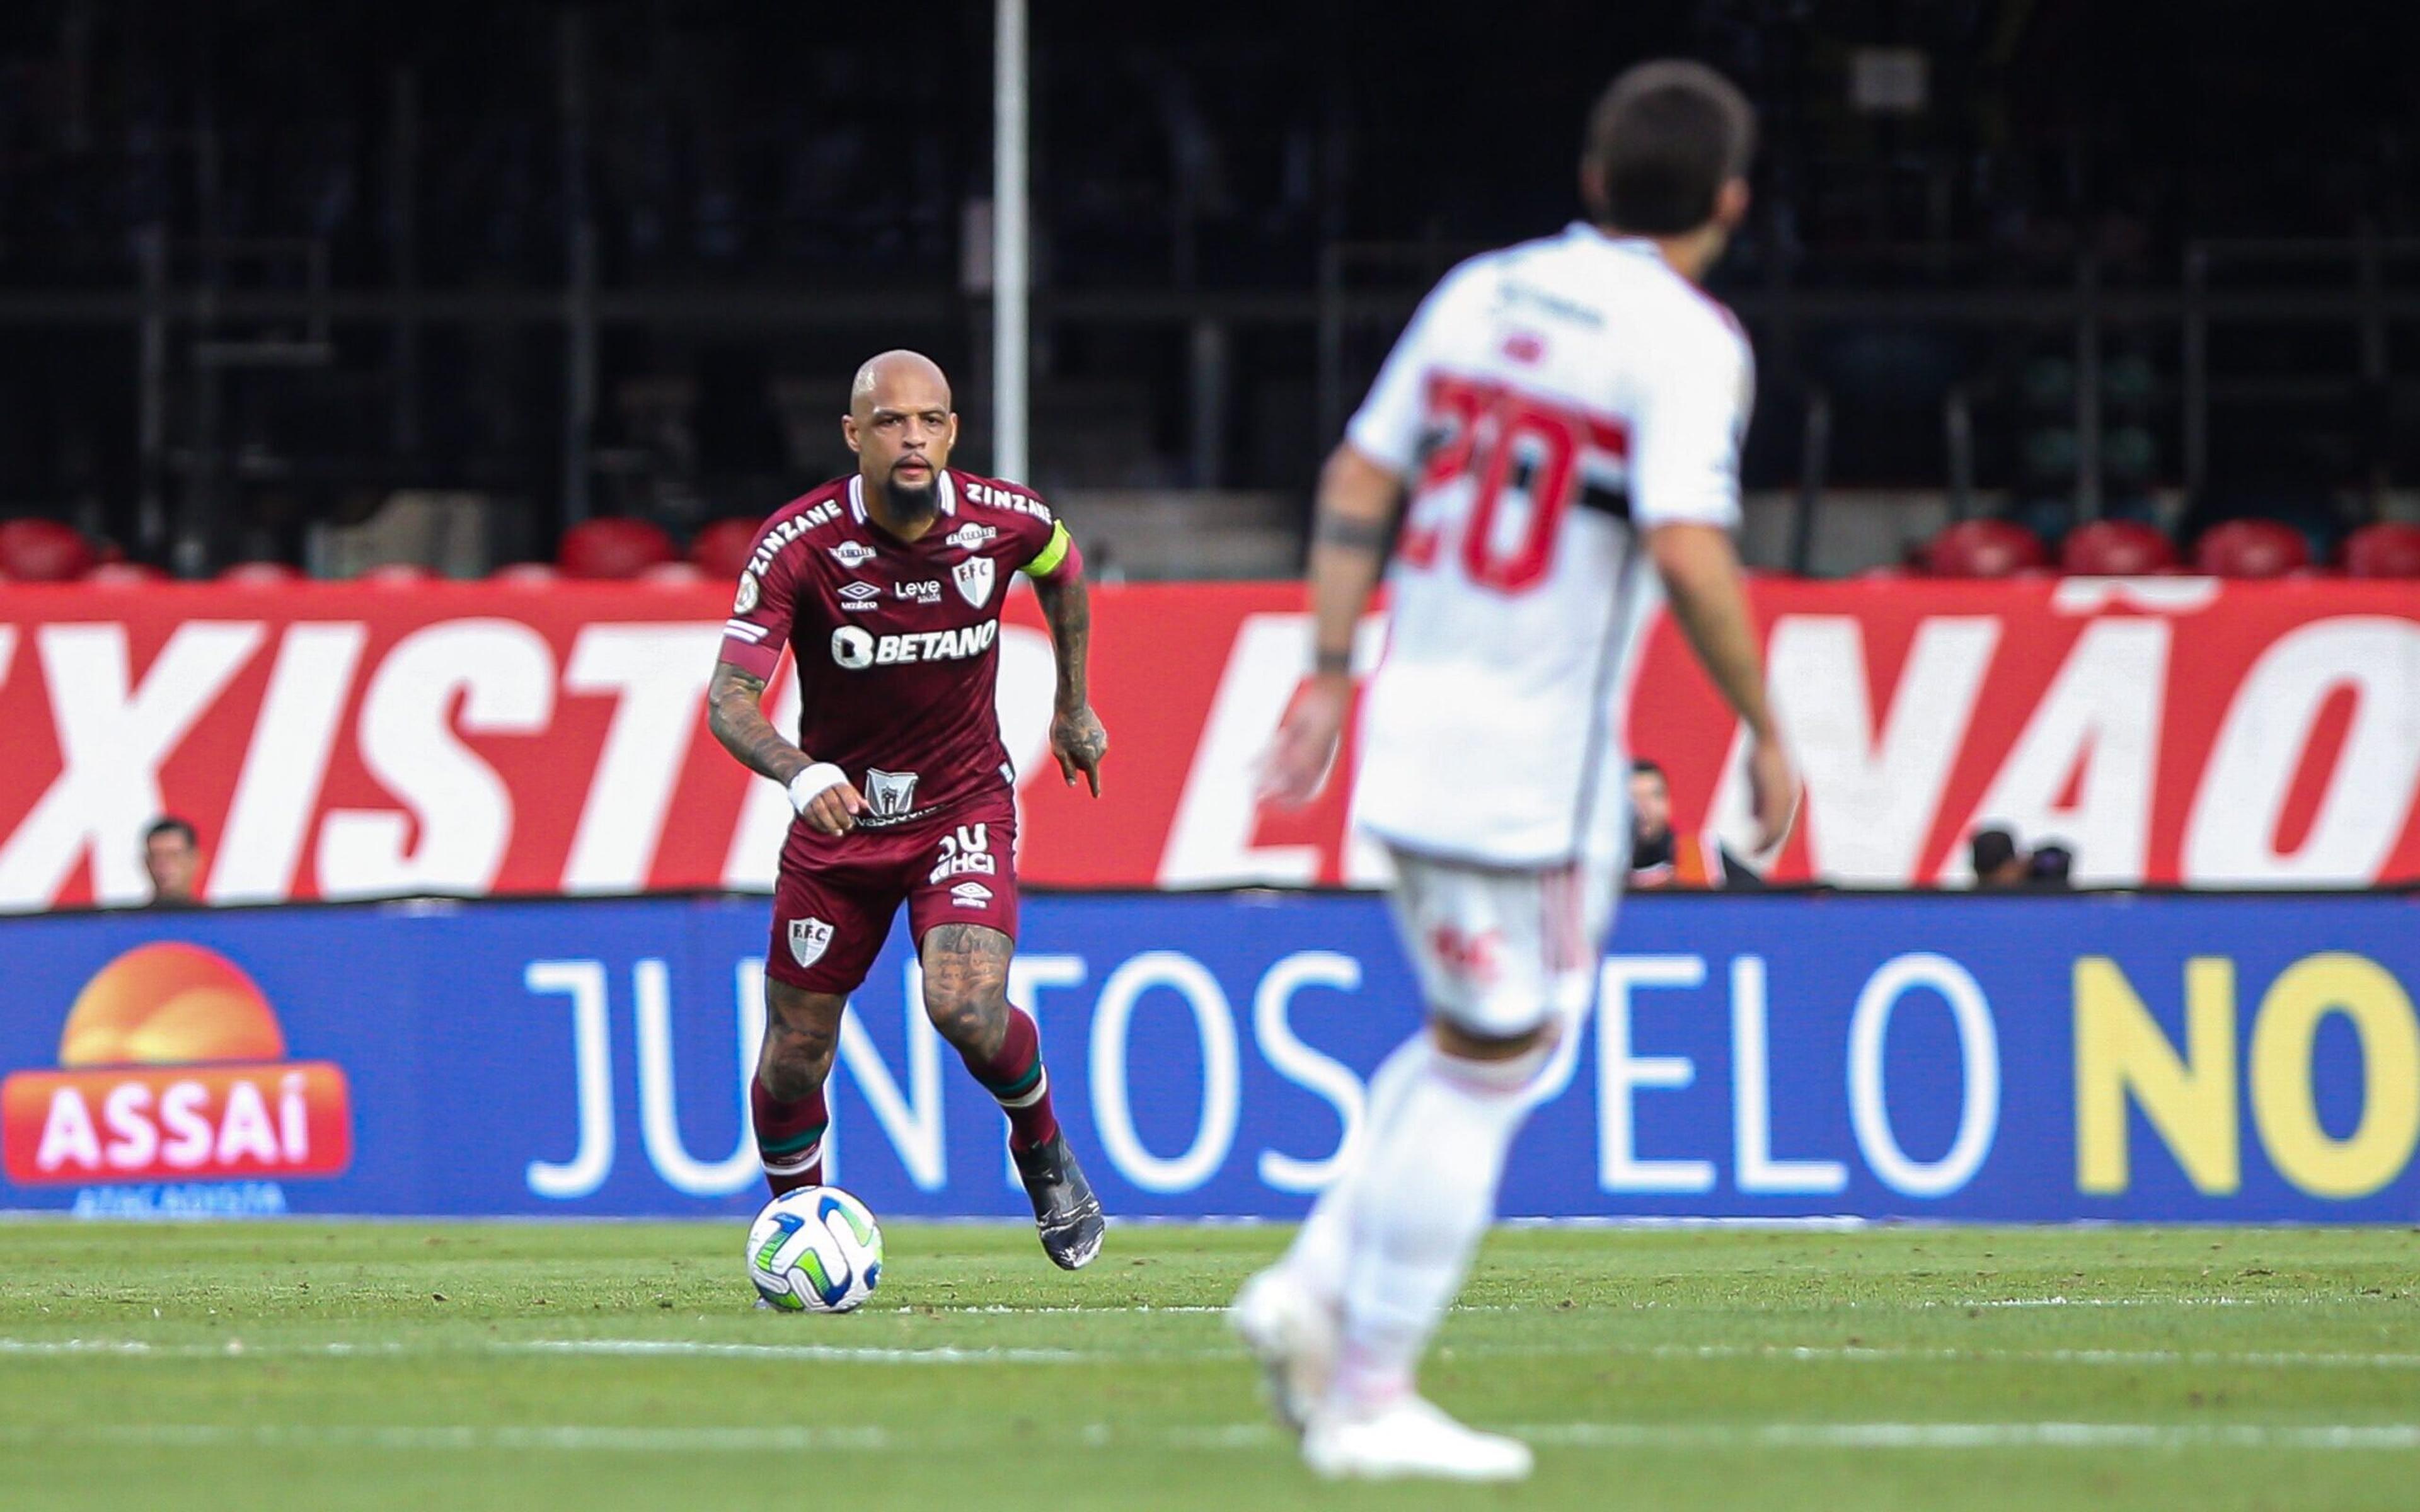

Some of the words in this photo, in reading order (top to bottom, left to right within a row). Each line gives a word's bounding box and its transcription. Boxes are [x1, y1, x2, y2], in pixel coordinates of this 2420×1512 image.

[1396, 372, 1577, 593] 20
[747, 499, 843, 576] ZINZANE
[895, 580, 941, 600] Leve
[875, 619, 997, 665] BETANO
[1525, 951, 2001, 1197] ELO
[2072, 951, 2420, 1198] NO
[36, 1072, 308, 1172] ASSAÍ
